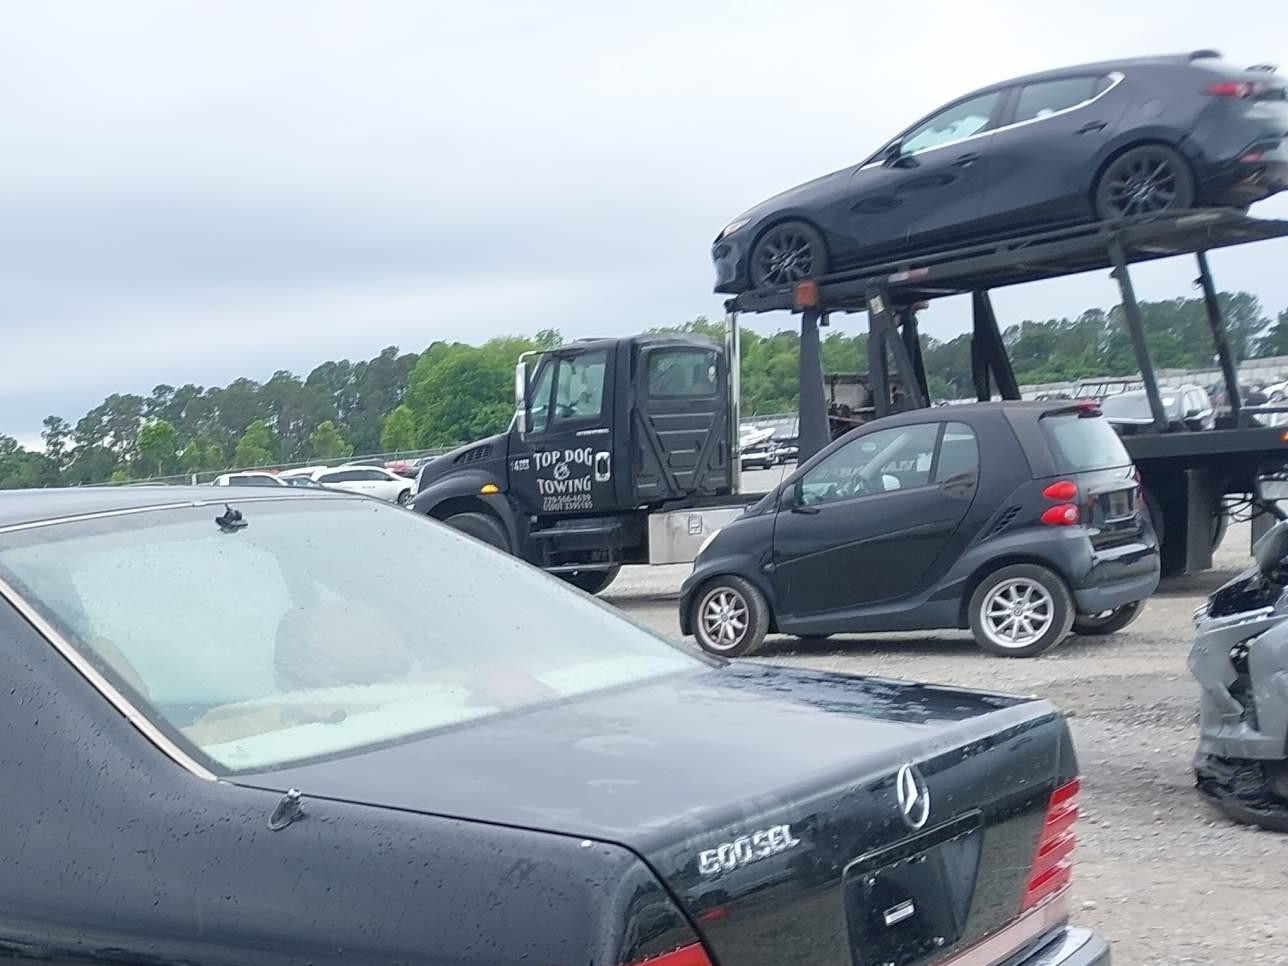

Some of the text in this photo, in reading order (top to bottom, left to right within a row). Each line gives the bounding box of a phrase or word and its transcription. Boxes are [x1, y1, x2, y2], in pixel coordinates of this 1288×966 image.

[533, 451, 561, 471] TOP
[564, 447, 593, 466] DOG
[536, 475, 591, 494] TOWING
